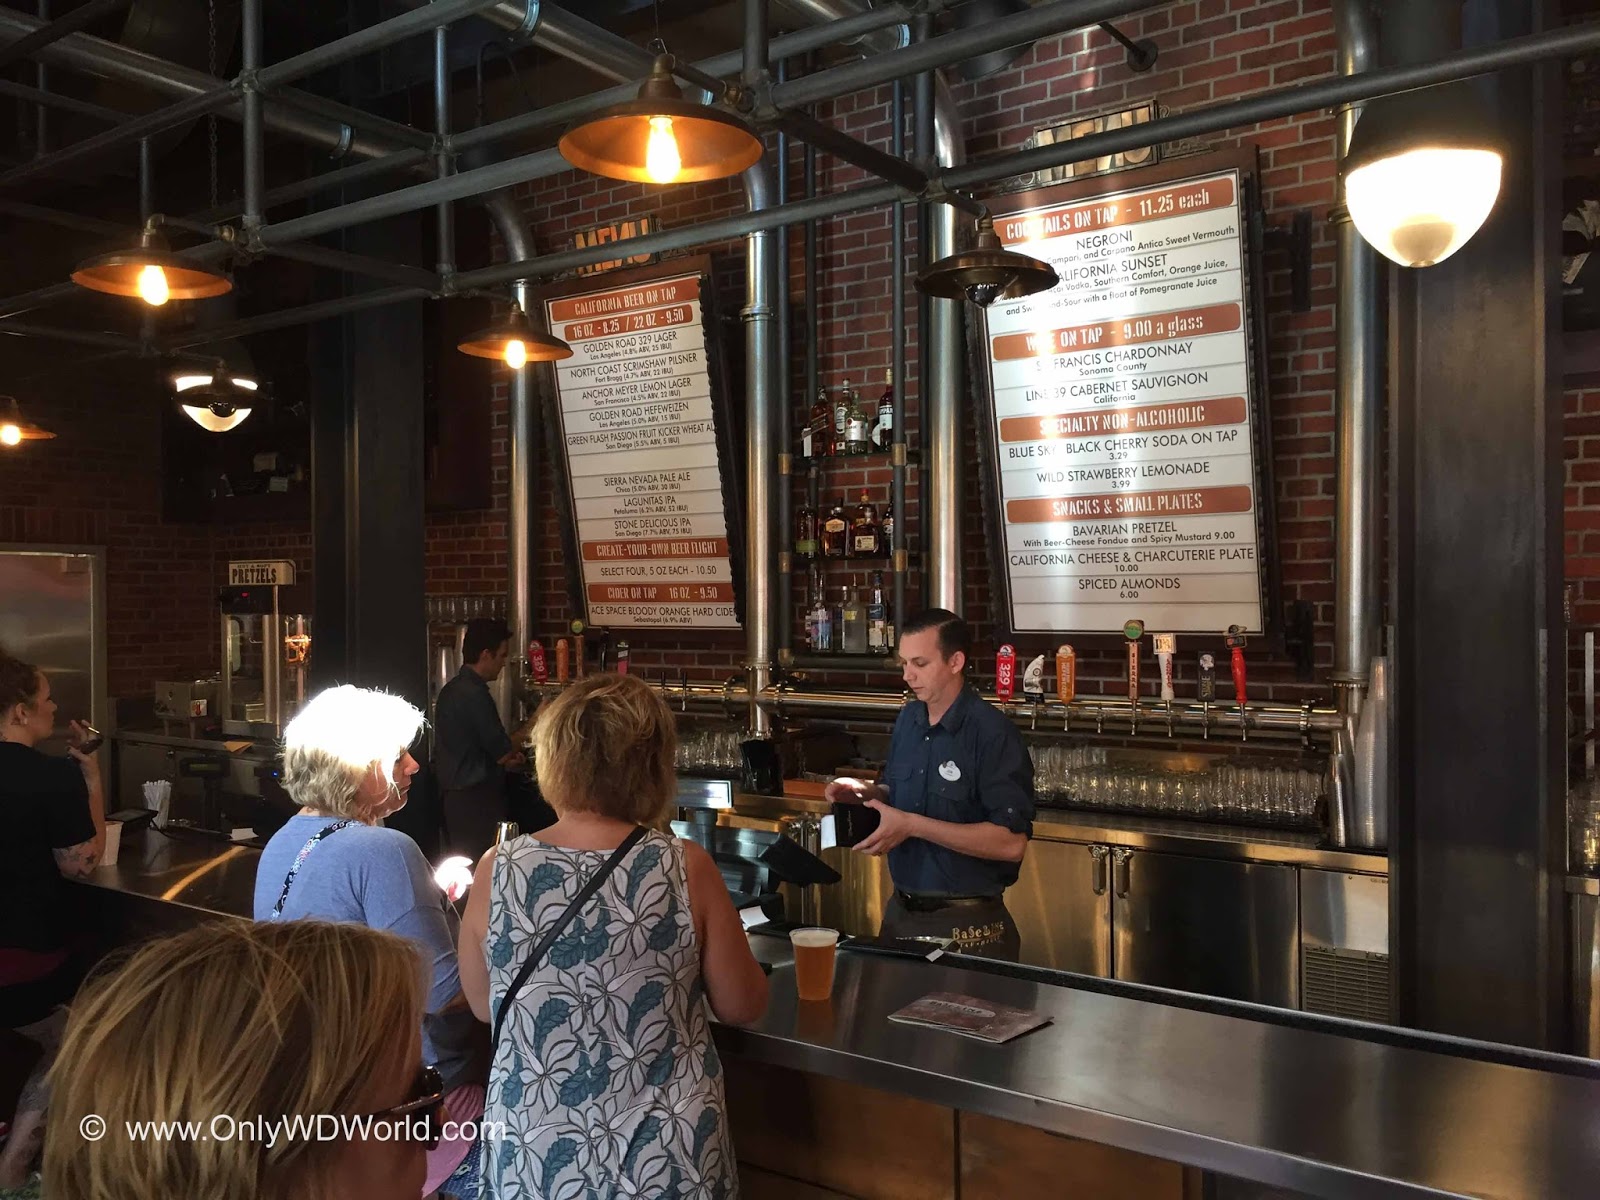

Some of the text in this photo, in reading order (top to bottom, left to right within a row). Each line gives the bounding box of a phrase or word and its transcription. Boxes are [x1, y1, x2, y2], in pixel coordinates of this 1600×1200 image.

[1074, 209, 1091, 228] ON
[1094, 205, 1118, 225] TAP
[1139, 193, 1174, 217] 11.25
[1178, 188, 1210, 209] each
[1076, 230, 1133, 250] NEGRONI
[1083, 248, 1099, 259] and
[1137, 237, 1163, 250] Antica
[1165, 232, 1191, 245] Sweet
[1193, 224, 1235, 240] Vermouth
[1057, 253, 1168, 284] ALIFORNIA SUNSET
[1065, 279, 1091, 291] Vodka,
[1131, 267, 1167, 281] Comfort,
[1169, 262, 1201, 277] Orange
[1203, 258, 1228, 270] Juice,
[574, 286, 676, 316] CALIFORNIA BEER ON TAP
[1006, 305, 1020, 315] and
[1083, 293, 1100, 303] with
[1109, 290, 1127, 299] float
[1129, 287, 1138, 297] of
[1139, 281, 1194, 295] Pomegranate
[1195, 276, 1218, 287] Juice
[572, 308, 684, 339] 16 OZ 8.25 22 OZ 9.50
[1062, 329, 1077, 347] ON
[1080, 326, 1103, 345] TAP
[1123, 319, 1152, 339] 9.00
[1156, 322, 1164, 335] a
[1167, 315, 1204, 338] glass
[582, 330, 677, 353] GOLDEN ROAD 329 LAGER
[570, 352, 698, 379] NORTH COAST SCRIMSHAW PILSNER
[1054, 353, 1101, 369] FRANCIS
[1104, 341, 1193, 363] CHARDONNAY
[1079, 362, 1148, 376] Sonoma County
[581, 377, 691, 400] ANCHOR MEYER LEMON LAGER
[1070, 380, 1127, 397] CABERNET
[1131, 371, 1208, 391] SAUVIGNON
[1093, 393, 1136, 404] California
[588, 401, 690, 422] GOLDEN ROAD HEFEWEIZEN
[1102, 405, 1204, 429] NON-ALCOHOLIC
[567, 422, 715, 446] GREEN FLASH PASSION FRUIT KICKER WHEAT AL
[1008, 445, 1035, 459] BLUE
[1066, 440, 1102, 454] BLACK
[1104, 436, 1149, 451] CHERRY
[1152, 434, 1188, 448] SODA
[1191, 431, 1212, 445] ON
[1215, 429, 1238, 442] TAP
[1108, 451, 1128, 461] 3.29
[603, 471, 691, 487] SIERRA NEVADA PALE ALE
[1036, 461, 1210, 483] WILD STRAWBERRY LEMONADE
[1111, 480, 1131, 489] 3.99
[623, 495, 677, 507] LAGUNITAS IPA
[1053, 492, 1203, 516] SNACKS & SMALL PLATES
[614, 517, 692, 530] STONE DELICIOUS IPA
[1072, 521, 1178, 537] BAVARIAN PRETZEL
[596, 541, 718, 557] CREATE-YOUR-OWN BEER FLIGHT
[1022, 530, 1235, 547] With Beer-Cheese Fondue and Spicy Mustard 9.00
[1010, 547, 1254, 566] CALIFORNIA CHEESE & CHARCUTERIE PLATE
[232, 568, 277, 584] PRETZELS
[600, 565, 717, 577] SELECT FOUR, 5 OZ EACH 10.50
[1115, 564, 1139, 573] 10.00
[607, 585, 718, 600] CIDER ON TAP 16 OZ 9.50
[1078, 577, 1181, 590] SPICED ALMONDS
[1119, 590, 1139, 599] 6.00
[591, 605, 605, 615] ACE
[605, 606, 627, 615] SPACE
[627, 606, 657, 615] BLOODY
[658, 606, 691, 617] ORANGE
[691, 607, 714, 616] HARD
[1000, 663, 1011, 686] 329
